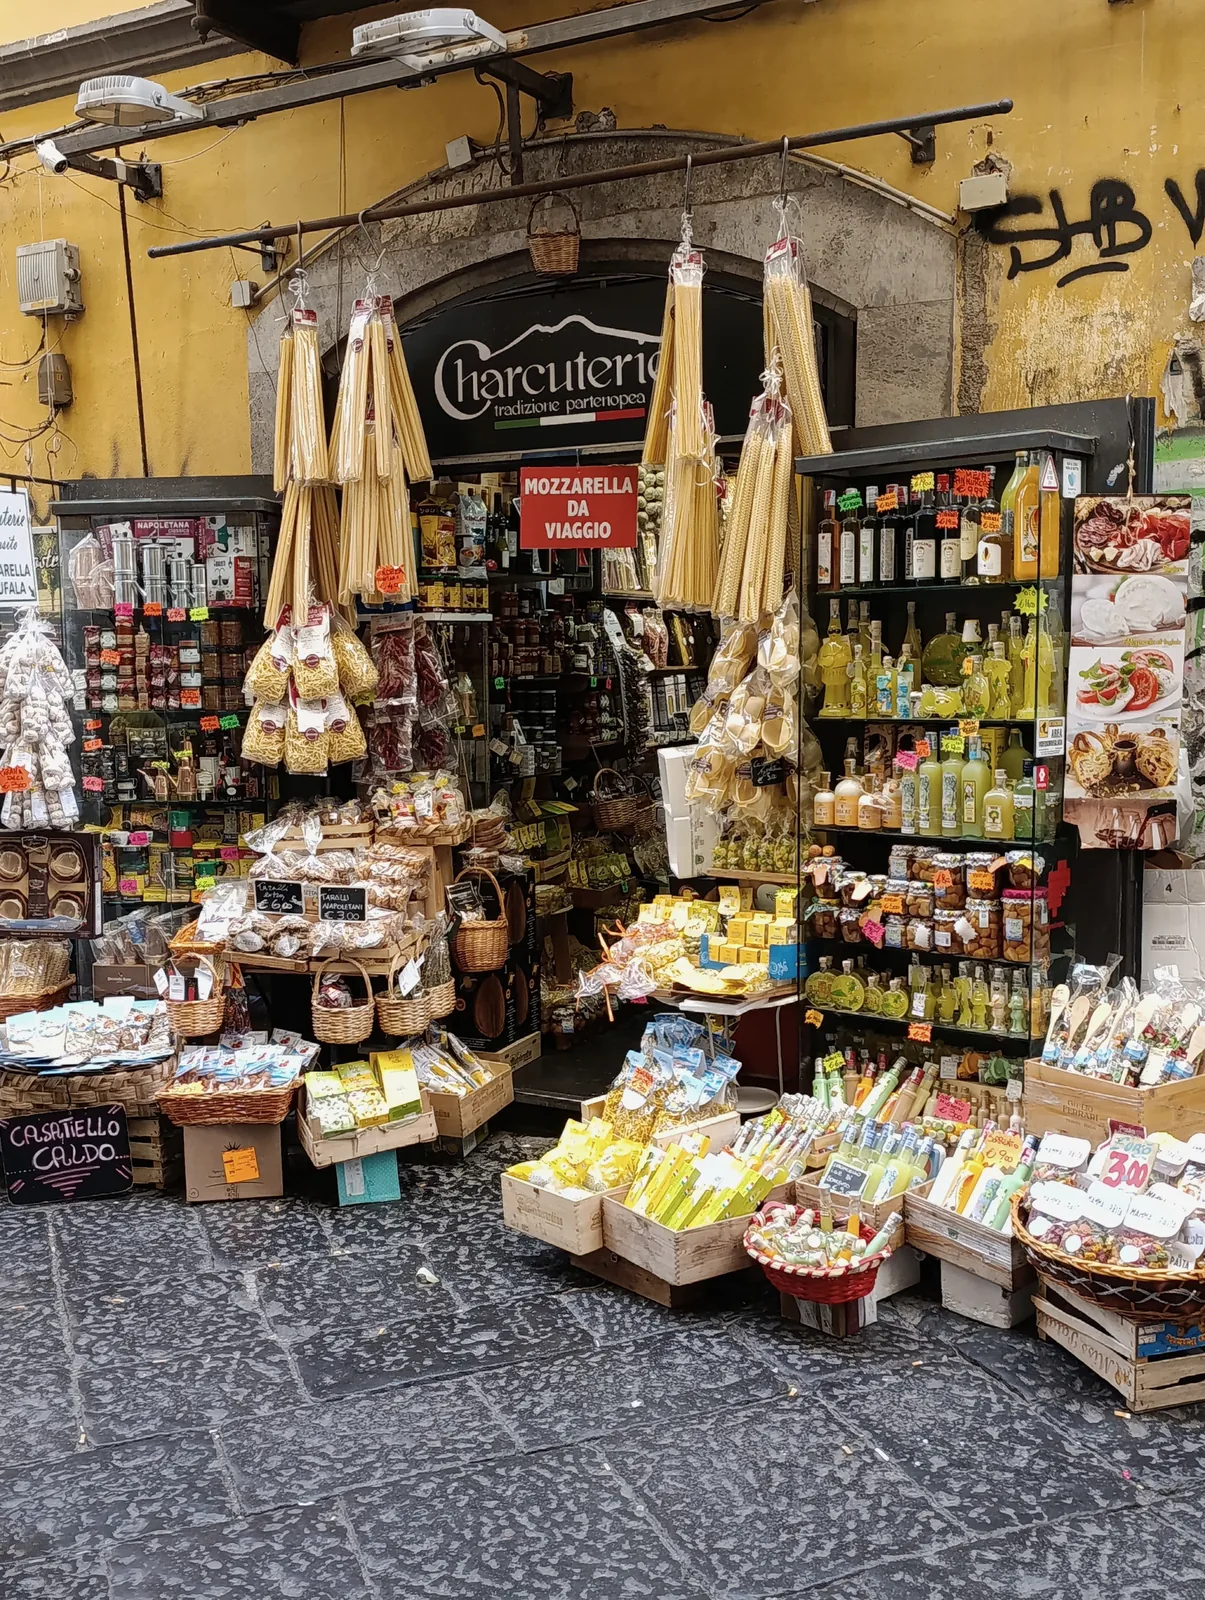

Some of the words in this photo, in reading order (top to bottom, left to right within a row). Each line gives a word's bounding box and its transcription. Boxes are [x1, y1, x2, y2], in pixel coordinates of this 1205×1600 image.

[494, 396, 560, 417] tradizione
[566, 392, 646, 413] partenopea
[524, 477, 633, 495] MOZZARELLA
[567, 500, 590, 517] DA
[137, 521, 190, 529] NAPOLETANA
[545, 521, 612, 539] VIAGGIO
[1165, 883, 1173, 893] 4
[321, 902, 363, 911] NAPOLETANI
[1062, 1105, 1099, 1122] FERRARI
[10, 1116, 121, 1147] CASATIELLO
